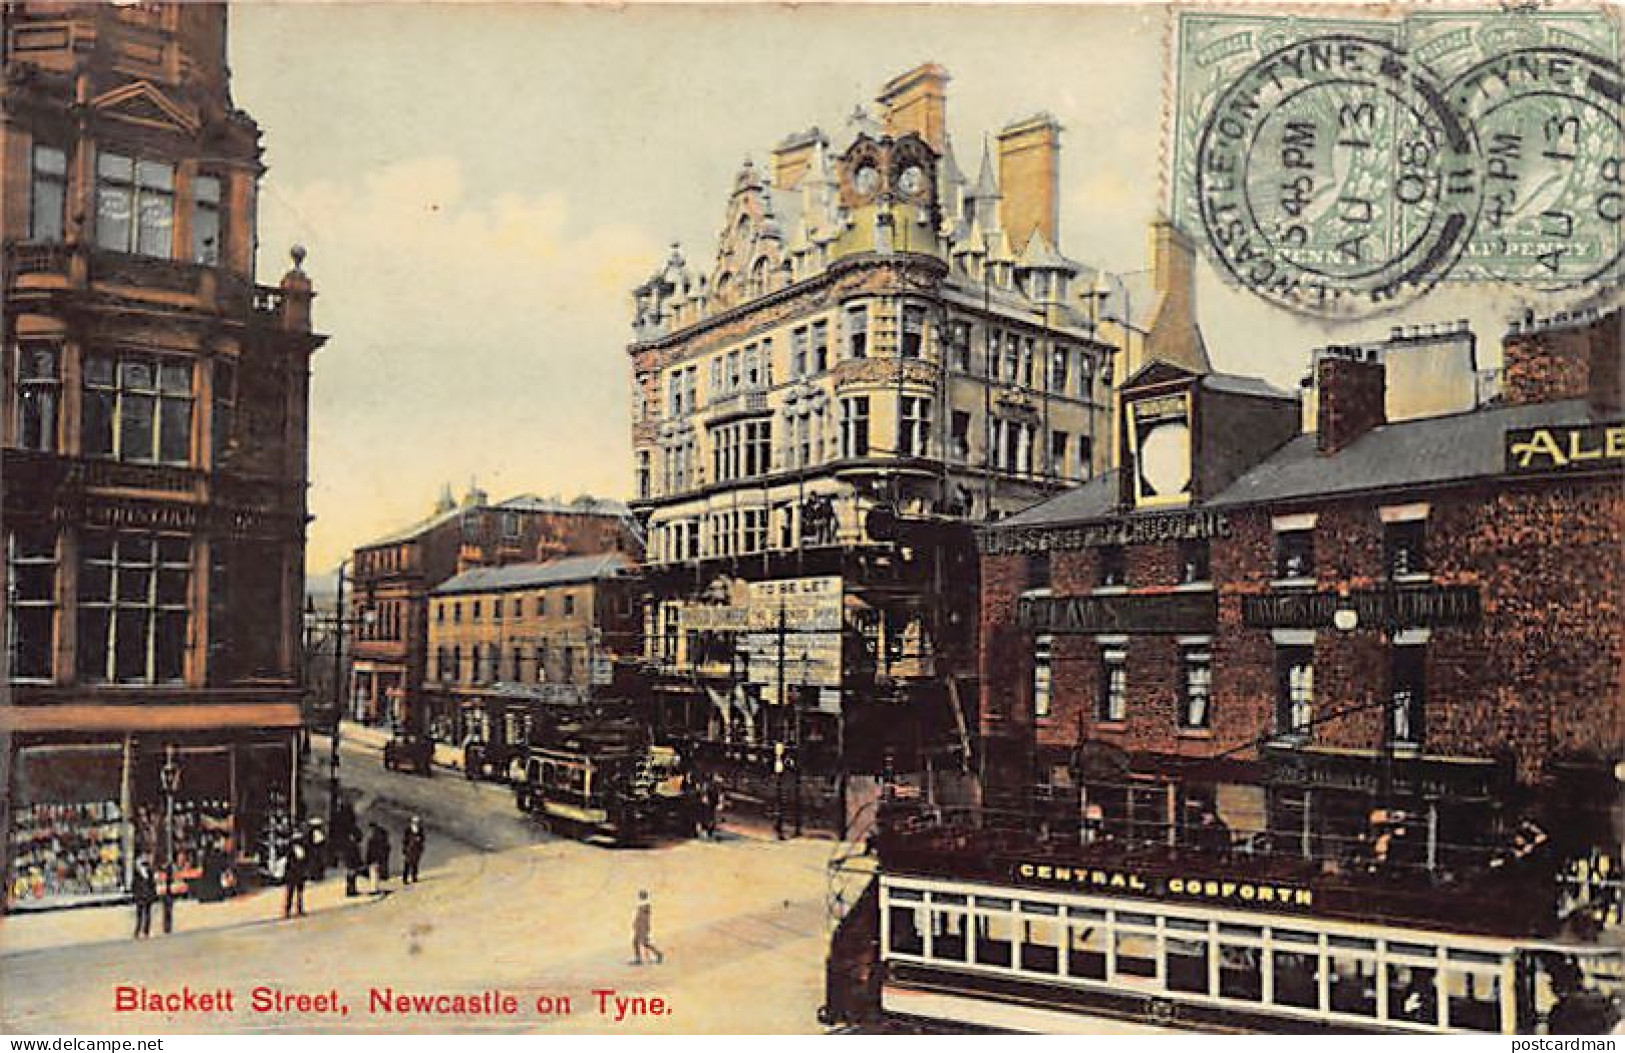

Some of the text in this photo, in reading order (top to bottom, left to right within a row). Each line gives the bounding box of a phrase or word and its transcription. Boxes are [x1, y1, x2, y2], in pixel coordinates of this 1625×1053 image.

[1336, 103, 1374, 259] AU 13
[1536, 116, 1579, 273] AU 13
[759, 580, 829, 594] TO BE LET
[1020, 864, 1313, 905] CENTRAL GOSFORTH
